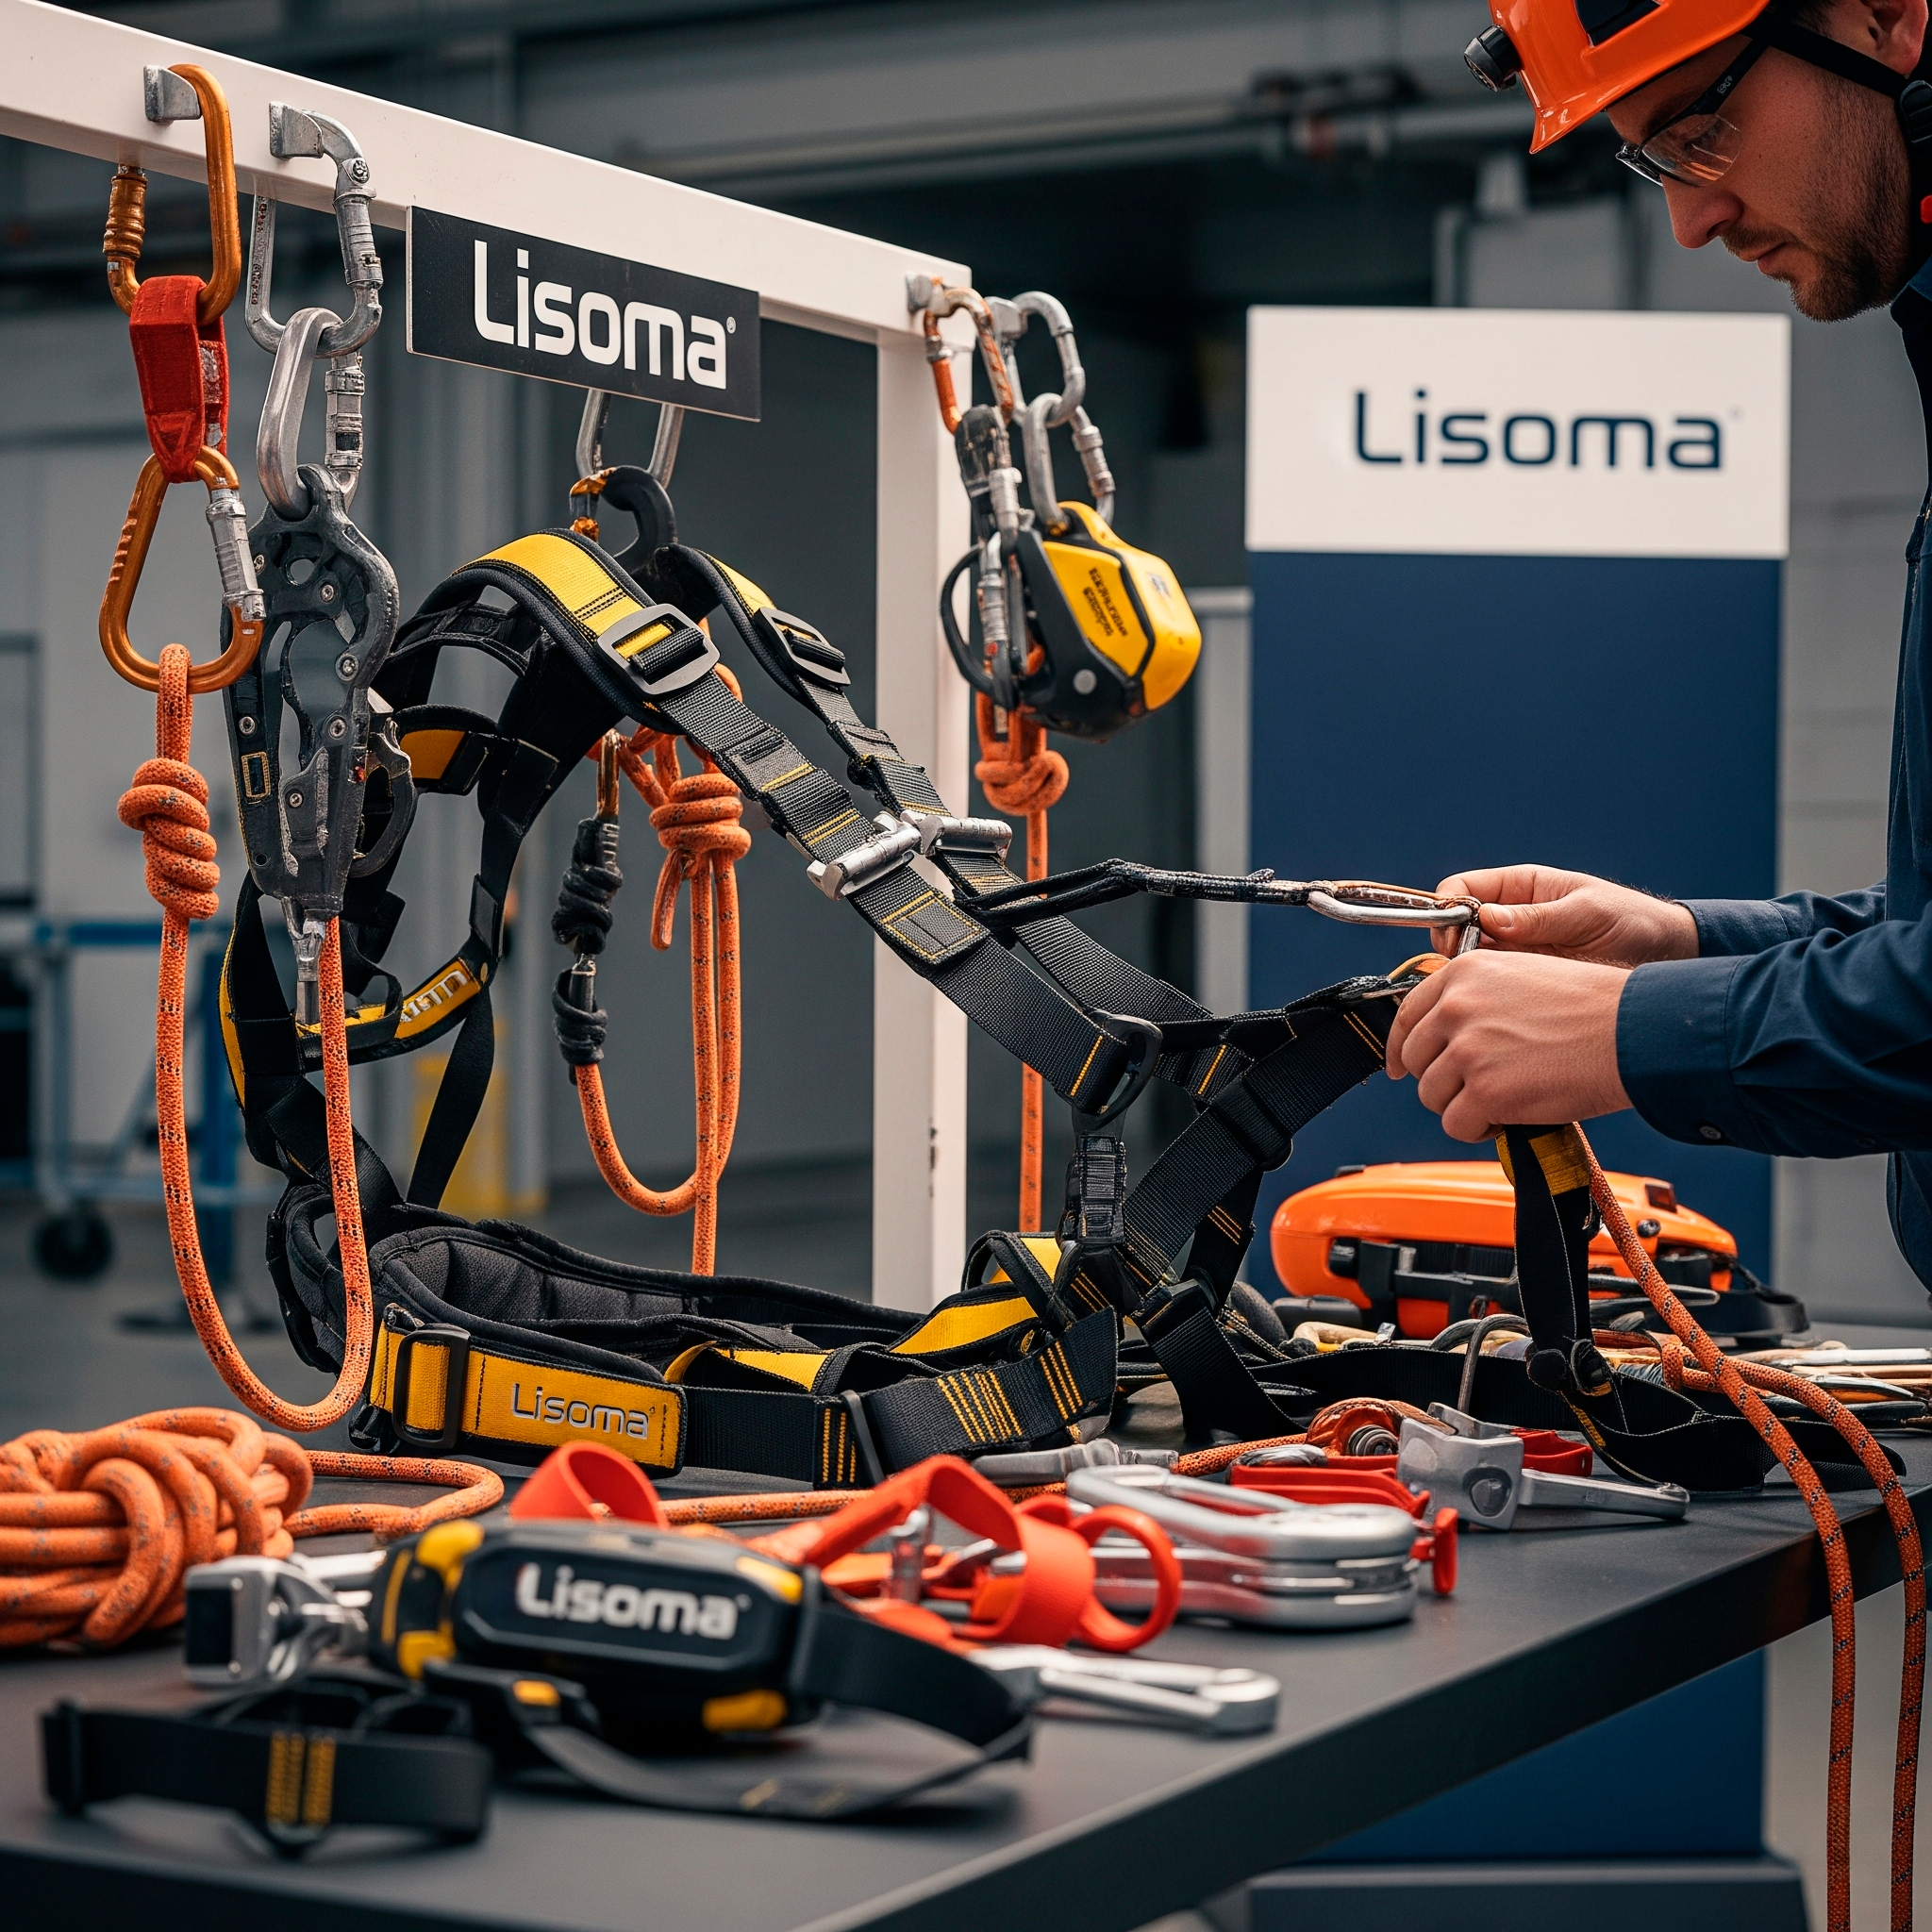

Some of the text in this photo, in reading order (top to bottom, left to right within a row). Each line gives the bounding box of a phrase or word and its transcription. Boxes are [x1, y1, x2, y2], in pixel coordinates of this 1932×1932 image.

[475, 240, 726, 390] Lisoma
[1356, 390, 1722, 470] Lisoma
[511, 1383, 648, 1440] Lisoma
[516, 1562, 738, 1640] Lisoma
